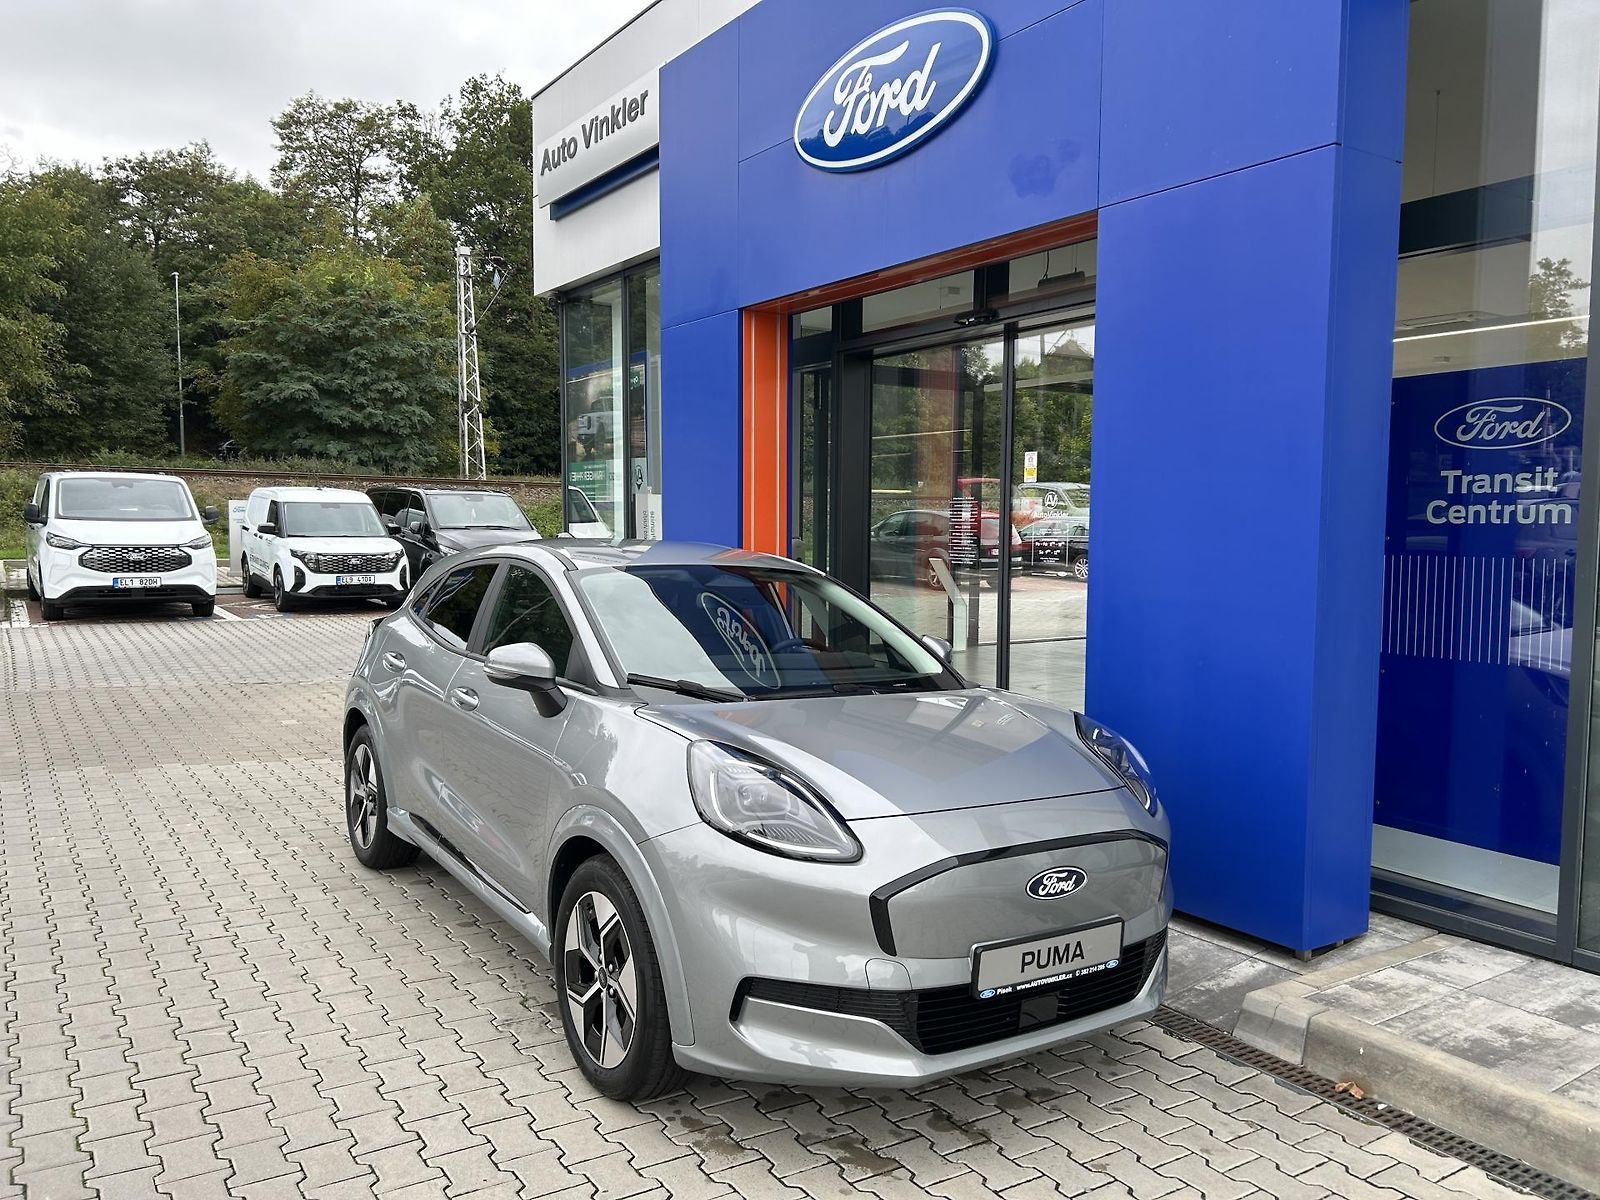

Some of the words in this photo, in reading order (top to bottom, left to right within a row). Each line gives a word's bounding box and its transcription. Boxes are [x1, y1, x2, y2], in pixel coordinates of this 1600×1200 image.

[823, 40, 942, 148] Ford
[540, 136, 578, 176] Auto
[581, 89, 649, 150] Vinkler
[1456, 404, 1546, 443] Ford
[1440, 466, 1559, 495] Transit
[1426, 499, 1572, 524] Centrum
[1038, 872, 1077, 896] Ford
[1020, 940, 1085, 974] PUMA
